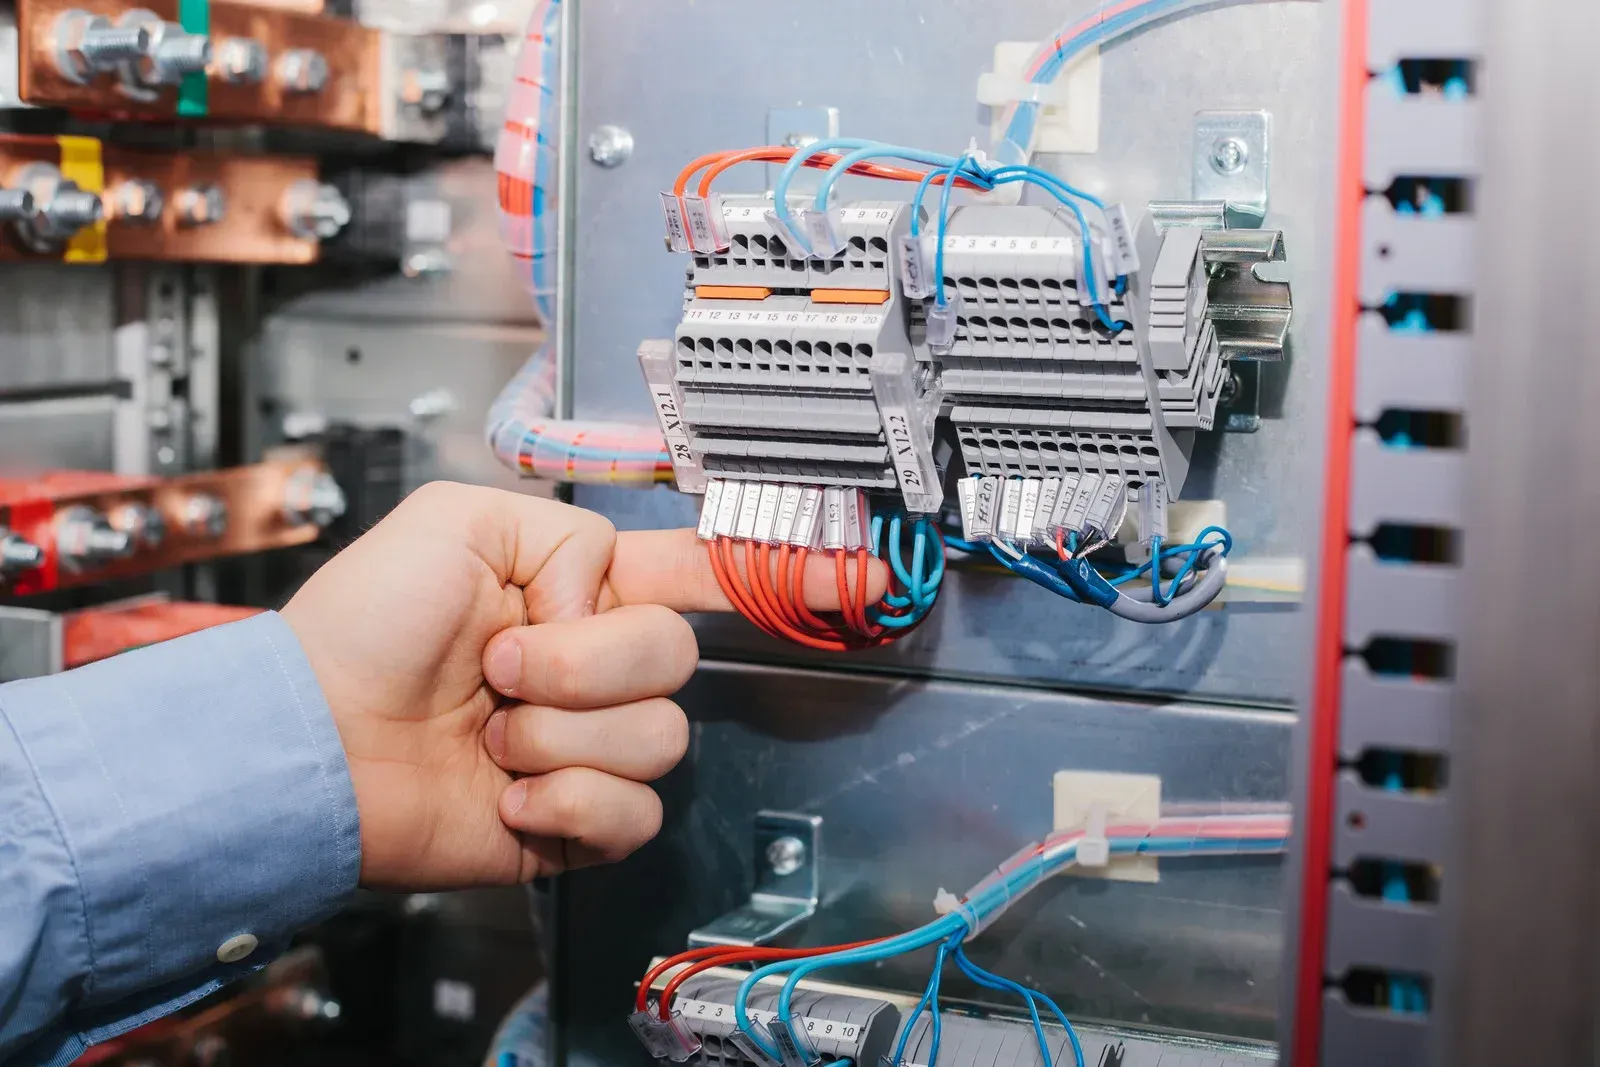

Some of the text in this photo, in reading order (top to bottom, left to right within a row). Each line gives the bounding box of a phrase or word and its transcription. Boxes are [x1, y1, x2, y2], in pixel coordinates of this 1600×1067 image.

[724, 208, 732, 216] 2
[742, 208, 751, 216] 3
[858, 210, 866, 218] 9
[875, 211, 888, 219] 10
[968, 239, 976, 248] 3
[989, 240, 997, 248] 4
[1010, 240, 1017, 249] 5
[1030, 240, 1038, 249] 6
[1052, 240, 1060, 248] 7
[709, 311, 721, 319] 12
[728, 312, 741, 320] 13
[748, 312, 760, 320] 14
[767, 313, 779, 321] 15
[806, 314, 818, 322] 17
[825, 315, 838, 323] 18
[863, 316, 878, 324] 20
[656, 391, 692, 460] 28 X12.1
[889, 415, 920, 487] 29 X12.2
[1023, 492, 1037, 519] 11:22
[1041, 488, 1057, 514] 11:23
[1073, 489, 1089, 515] 11:25
[1101, 481, 1119, 505] 11:26
[829, 503, 840, 523] 15:2
[697, 1005, 706, 1014] 2
[715, 1008, 723, 1017] 3
[807, 1021, 815, 1031] 8
[825, 1024, 833, 1034] 9
[842, 1026, 855, 1037] 10
